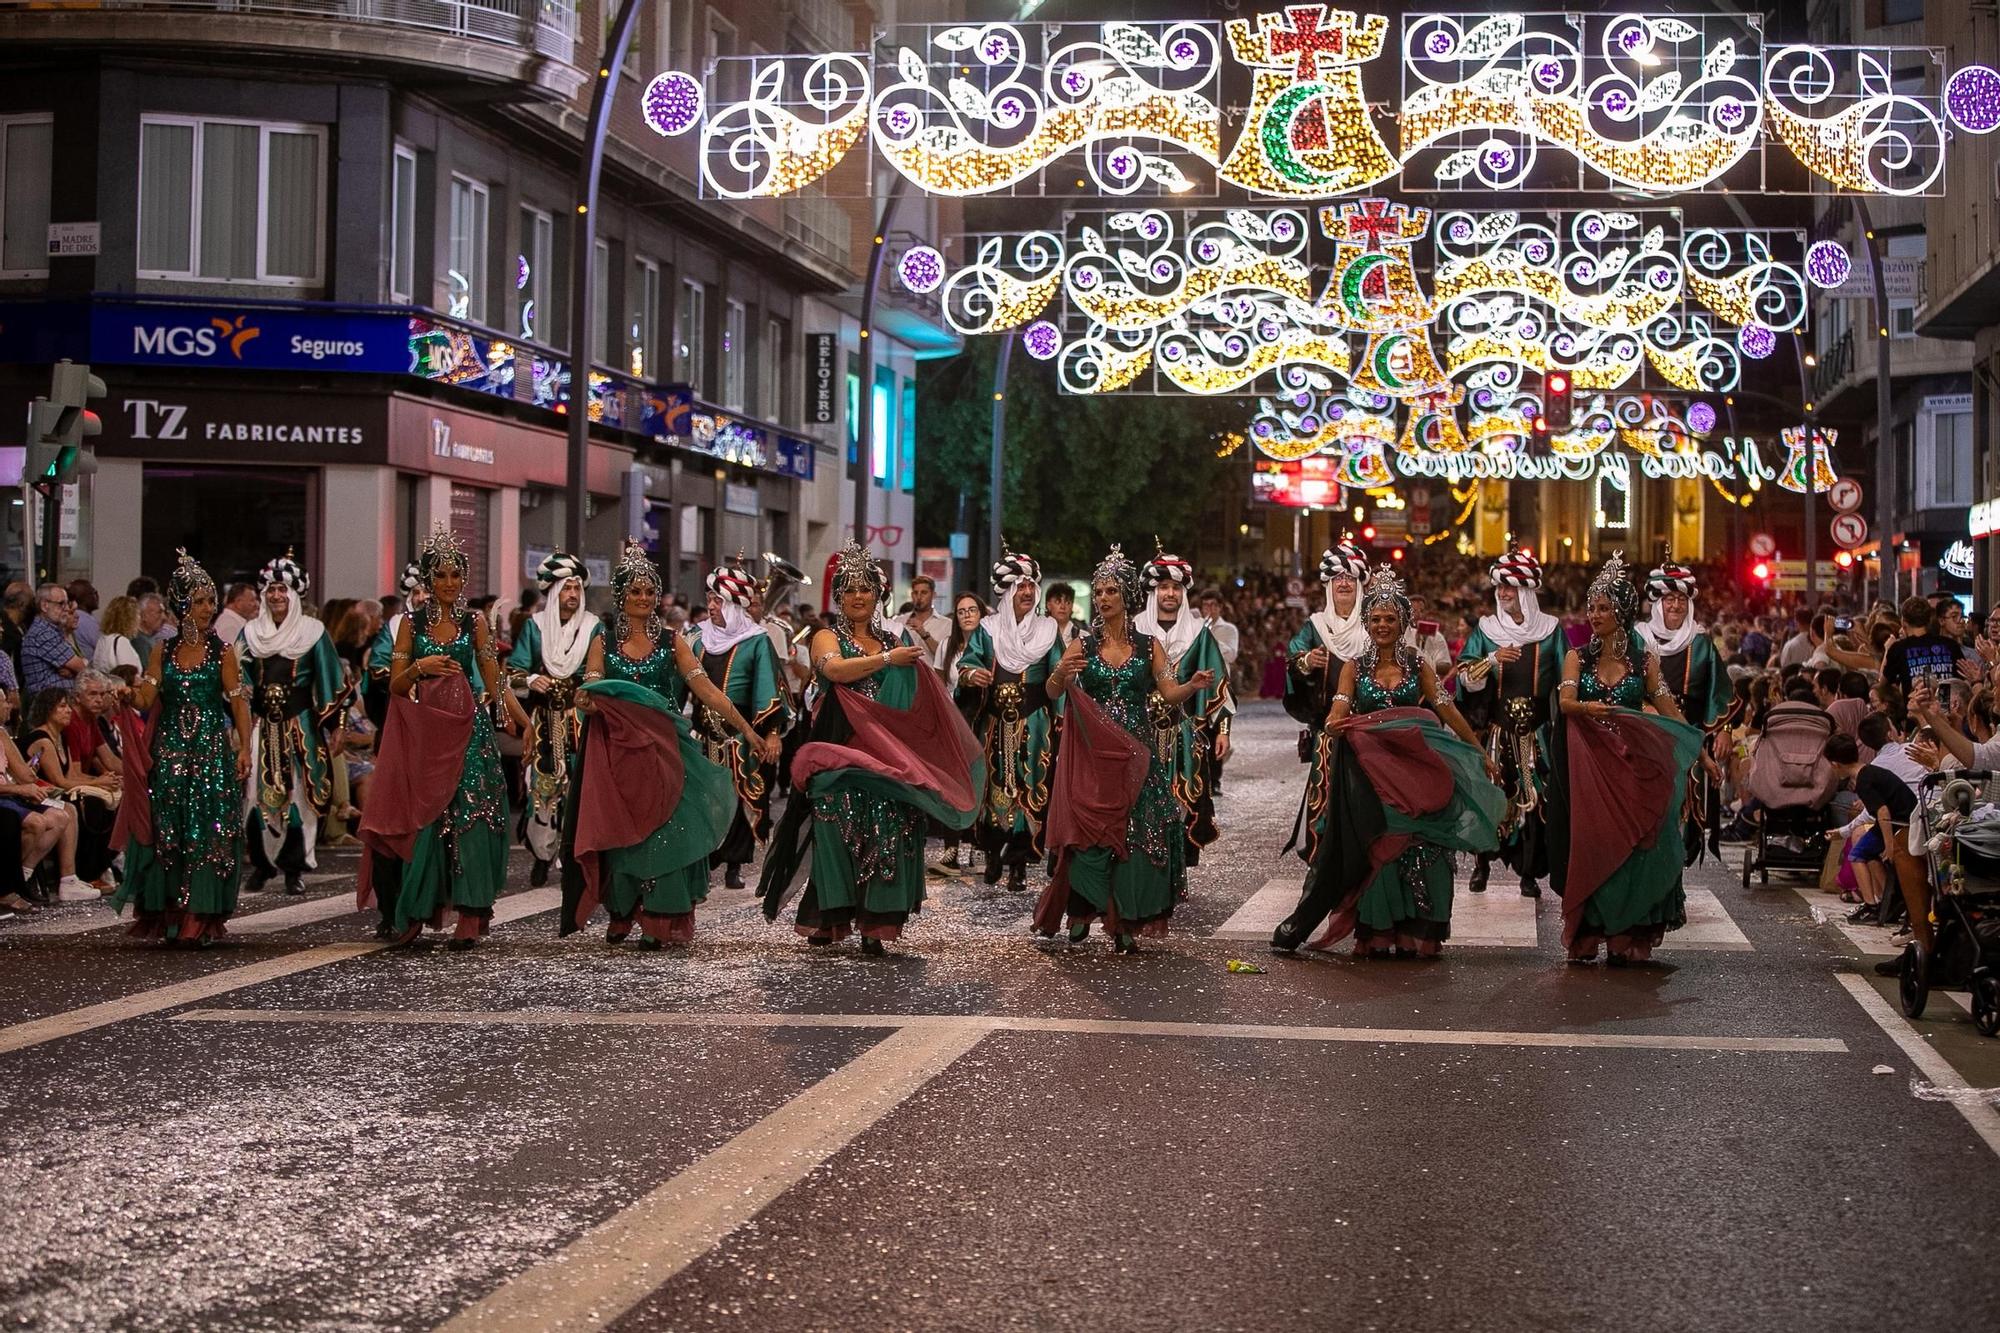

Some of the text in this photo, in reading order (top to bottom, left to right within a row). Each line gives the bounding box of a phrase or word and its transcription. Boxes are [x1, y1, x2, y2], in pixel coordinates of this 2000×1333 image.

[62, 234, 94, 244] MADRE
[62, 243, 97, 253] DE DIOS
[133, 326, 364, 360] MGS Seguros
[817, 335, 831, 422] RELOJERO
[205, 423, 363, 444] FABRICANTES
[1917, 656, 1931, 665] NOT
[1930, 663, 1953, 674] DON'T
